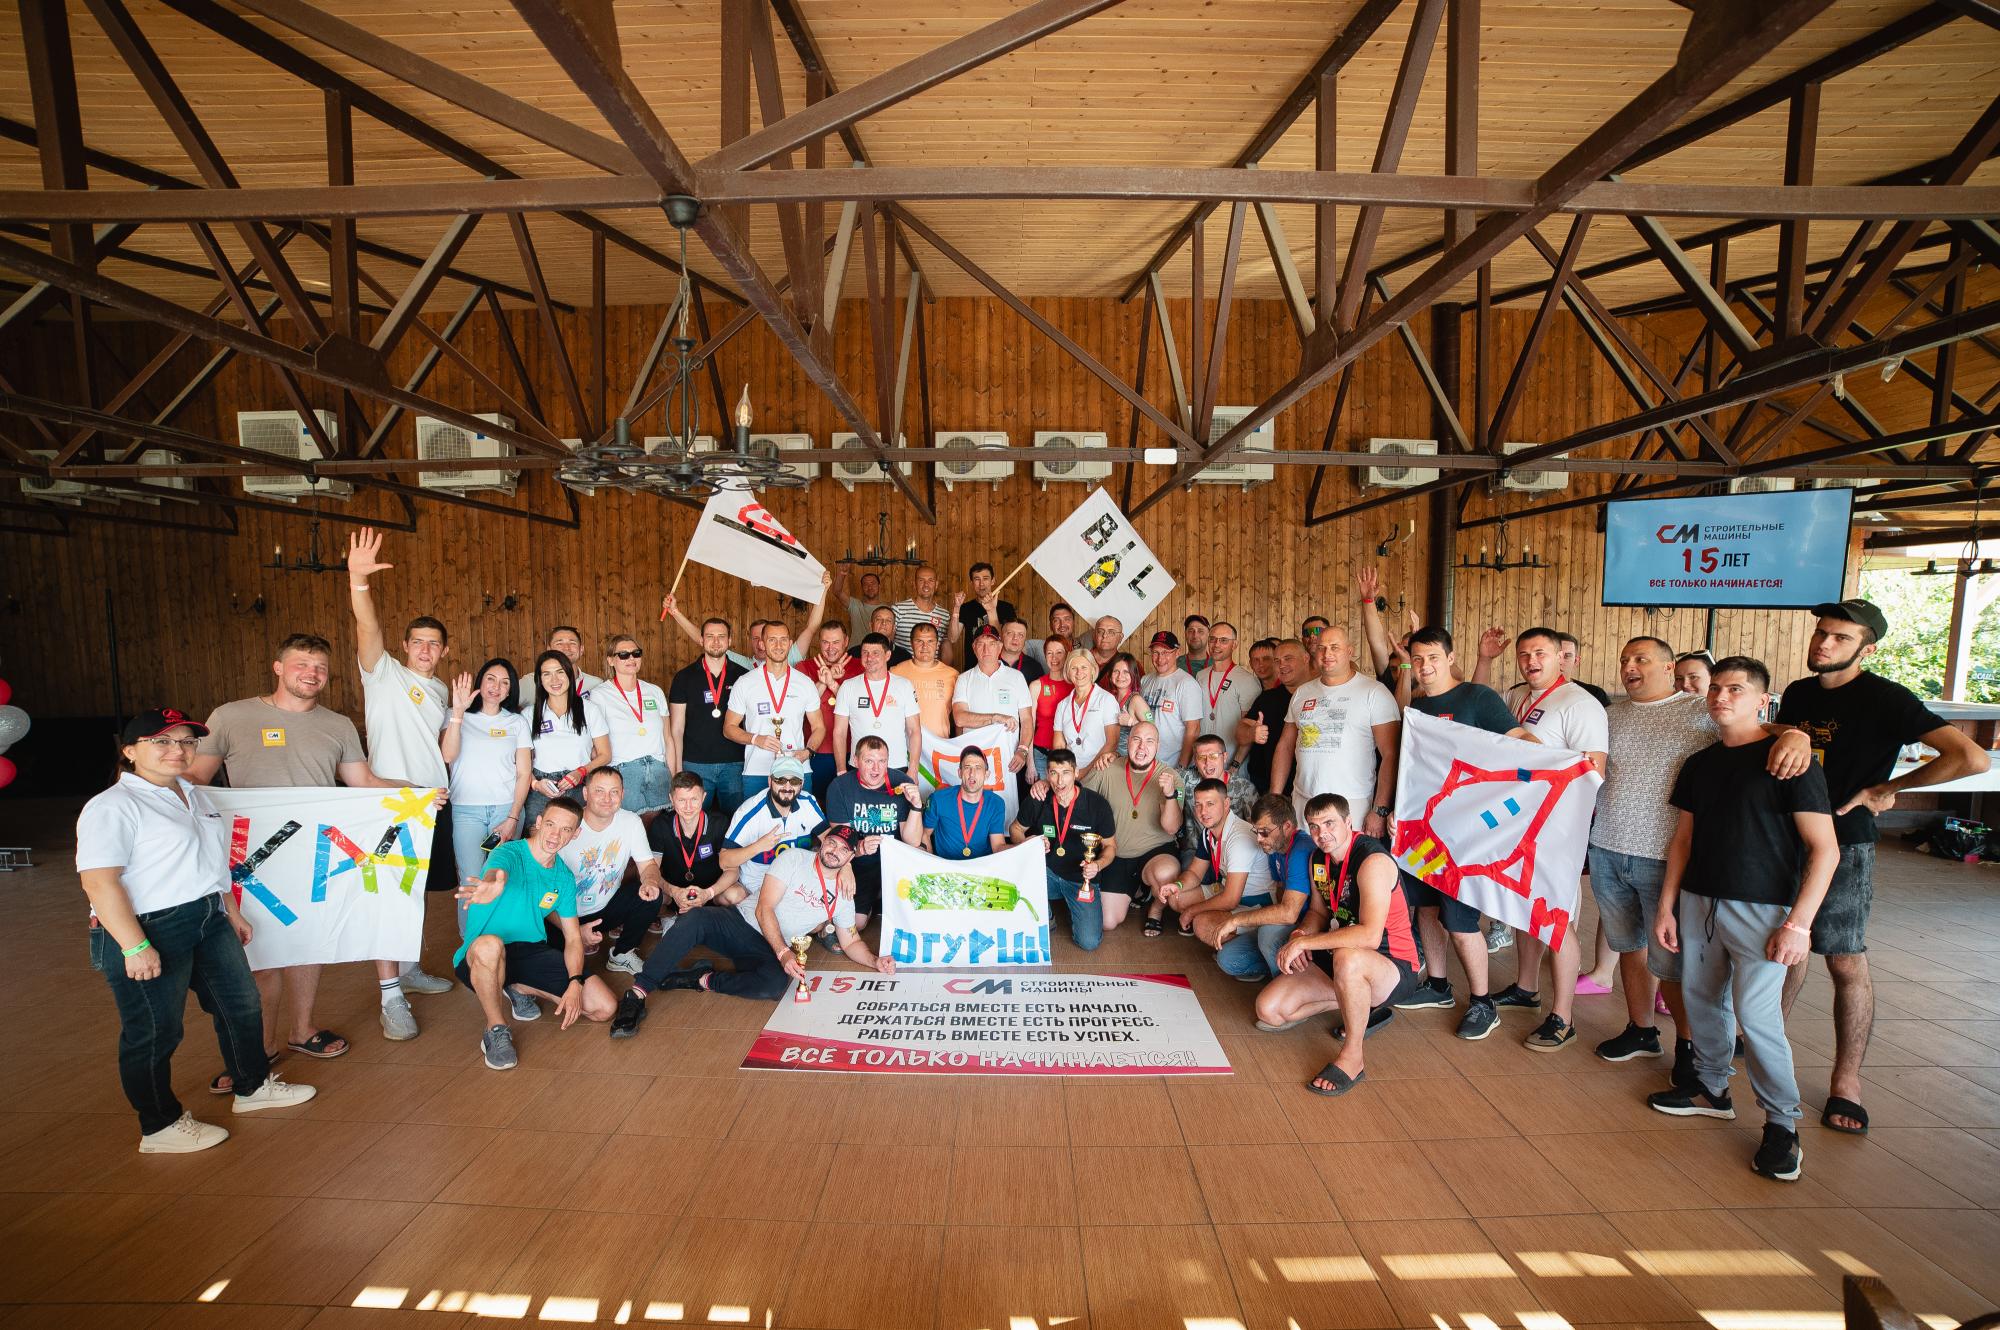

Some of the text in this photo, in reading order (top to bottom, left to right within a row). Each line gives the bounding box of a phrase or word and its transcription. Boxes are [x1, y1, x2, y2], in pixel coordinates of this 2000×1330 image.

[1656, 523, 1700, 543] СМ
[1704, 523, 1785, 533] СТРОИТЕЛЬНЫЕ
[1703, 532, 1751, 541] МАШИНЫ
[1682, 547, 1750, 574] 15 ЛЕТ
[1649, 578, 1783, 589] ВСЕ ТОЛЬКО НАЧИНАЕТСЯ!
[809, 976, 900, 994] 15 ЛЕТ
[943, 979, 1012, 994] СМ
[1020, 980, 1139, 988] СТРОИТЕЛЬНЫЕ
[856, 1001, 1143, 1013] СОБРАТЬСЯ ВМЕСТЕ ЕСТЬ НАЧАЛО.
[837, 1014, 1160, 1027] ДЕРЖАТЬСЯ ВМЕСТЕ ЕСТЬ ПРОГРЕСС.
[857, 1028, 1140, 1042] РАБОТАТЬ ВМЕСТЕ ЕСТЬ УСПЕХ.
[780, 1046, 1199, 1068] ВСЕ ТОЛЬКО НАЧИНАЕТСЯ!
